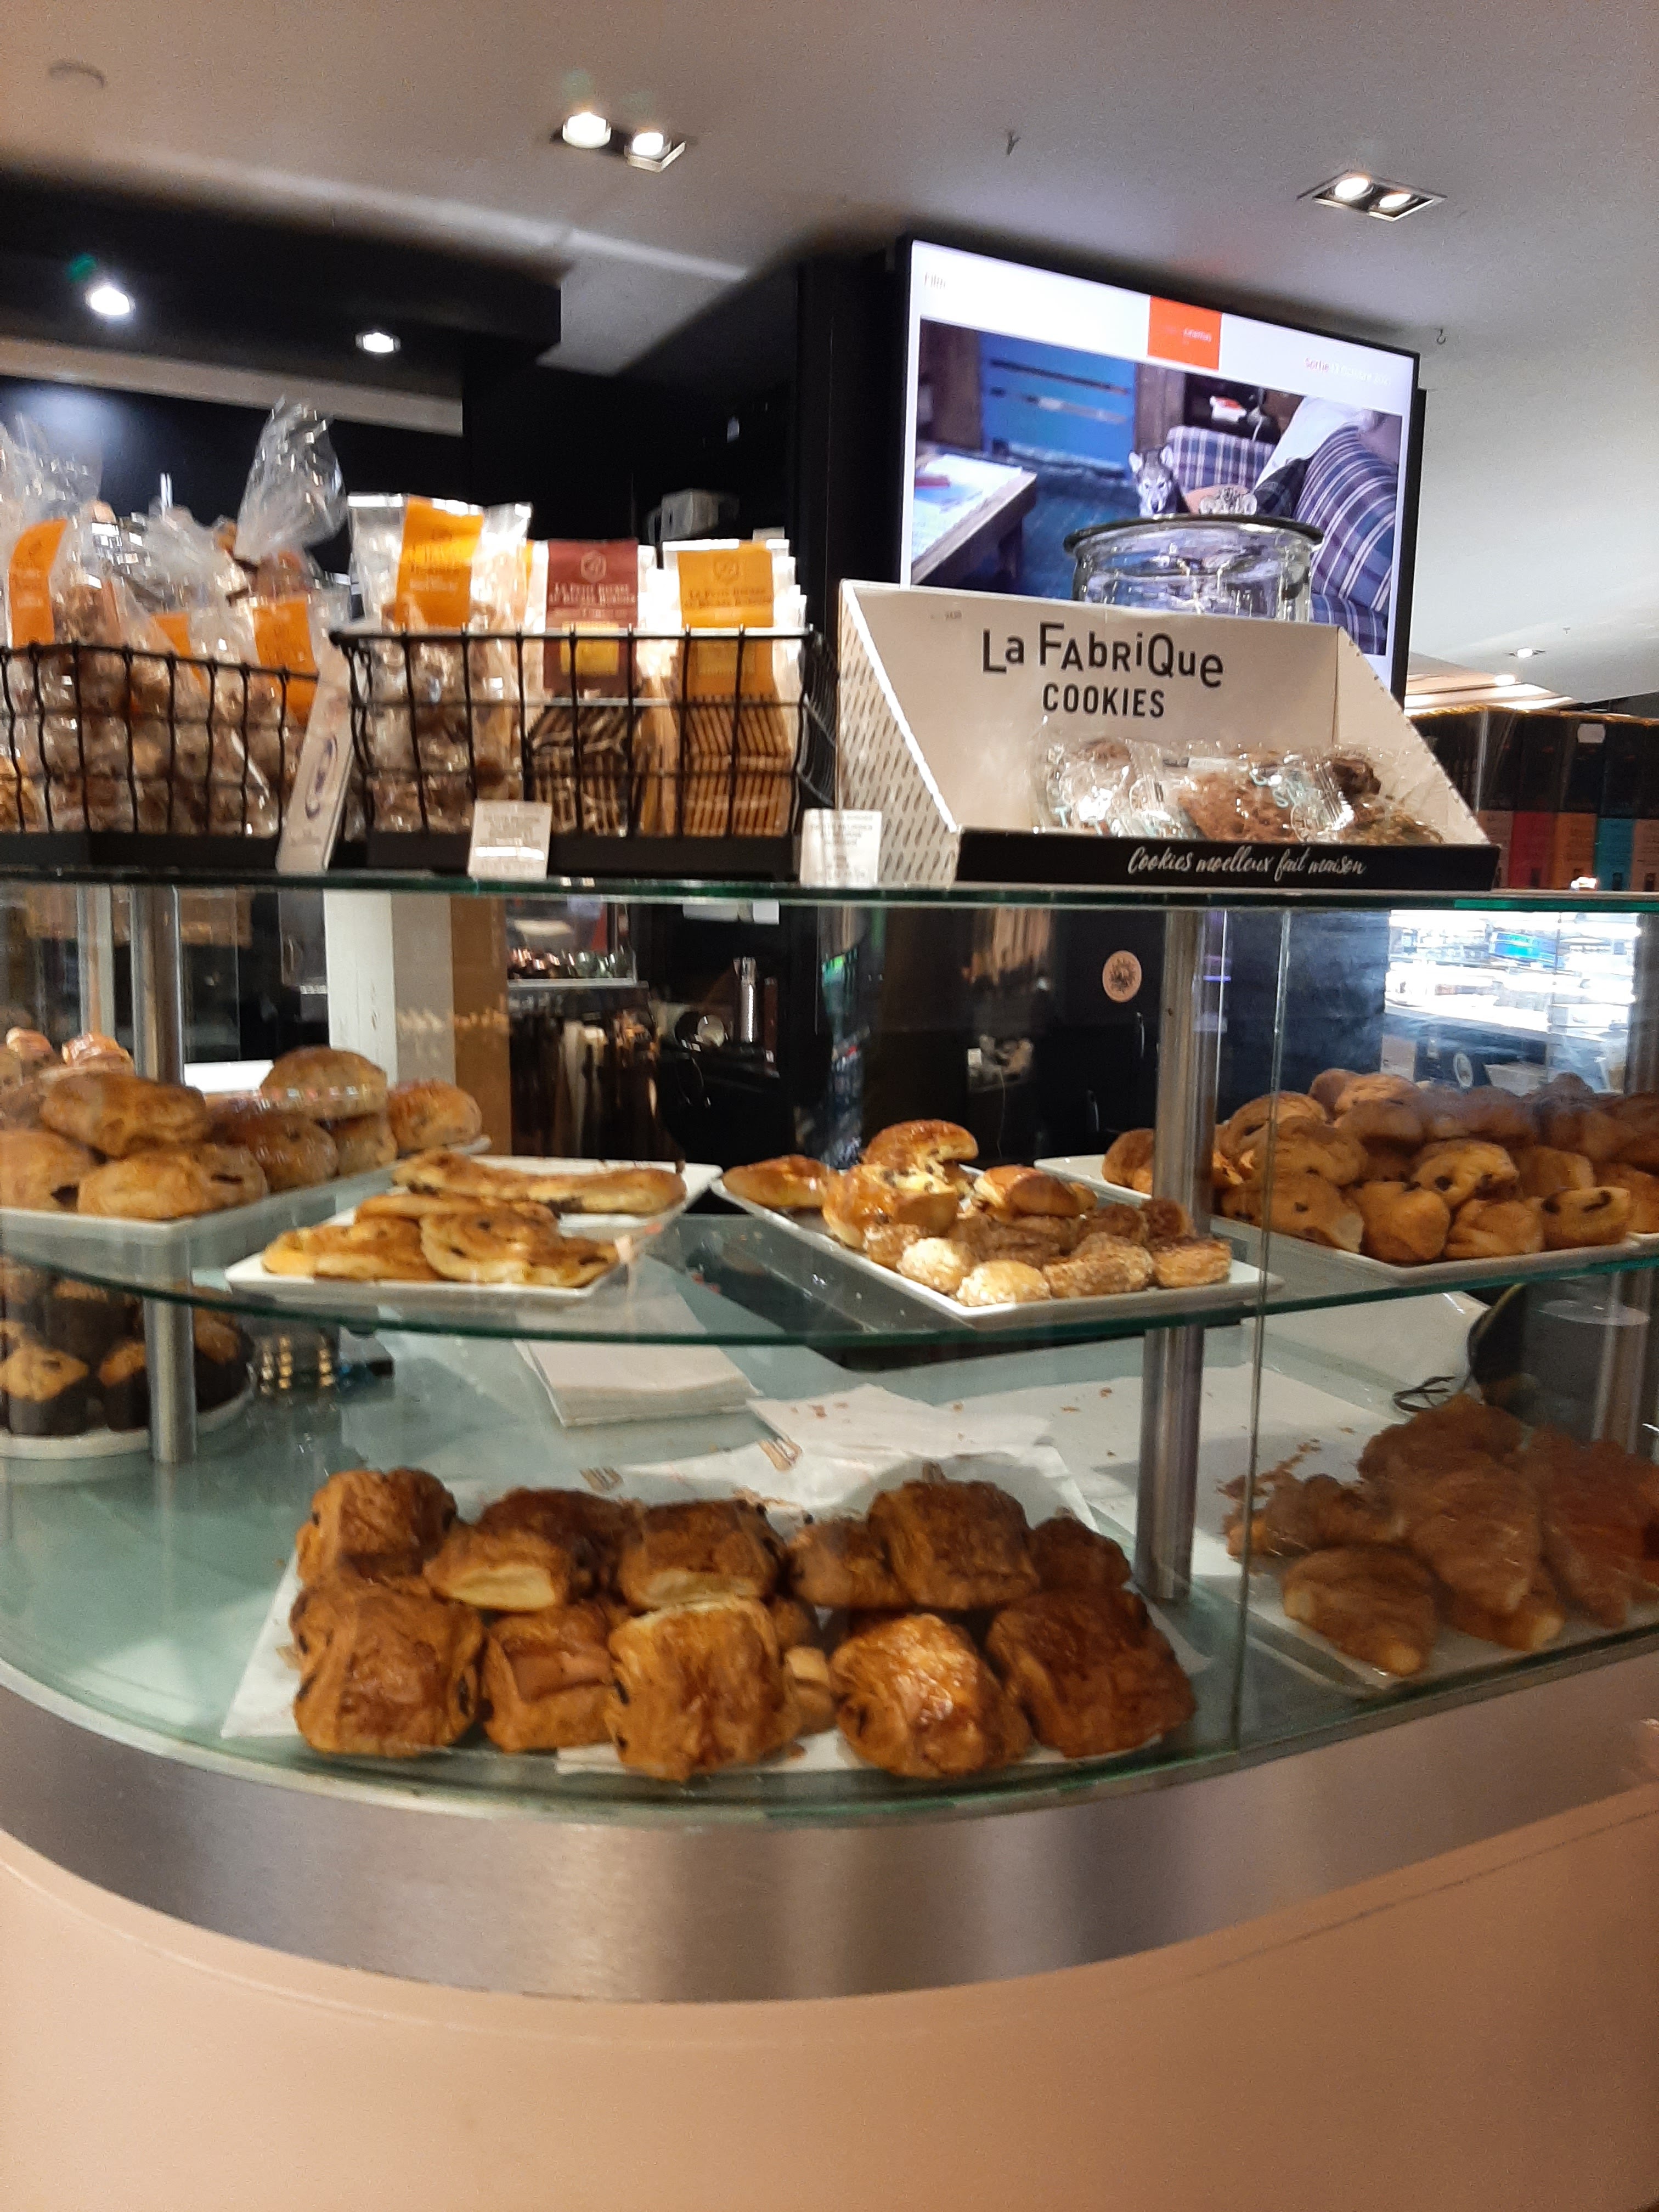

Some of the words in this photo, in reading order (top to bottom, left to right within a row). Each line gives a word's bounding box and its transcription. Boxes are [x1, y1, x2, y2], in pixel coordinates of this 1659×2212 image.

[983, 628, 1025, 674] La
[1043, 682, 1165, 718] COOKIES
[1128, 846, 1194, 874] Cookies
[1274, 846, 1311, 882] fait
[1307, 855, 1366, 875] maison
